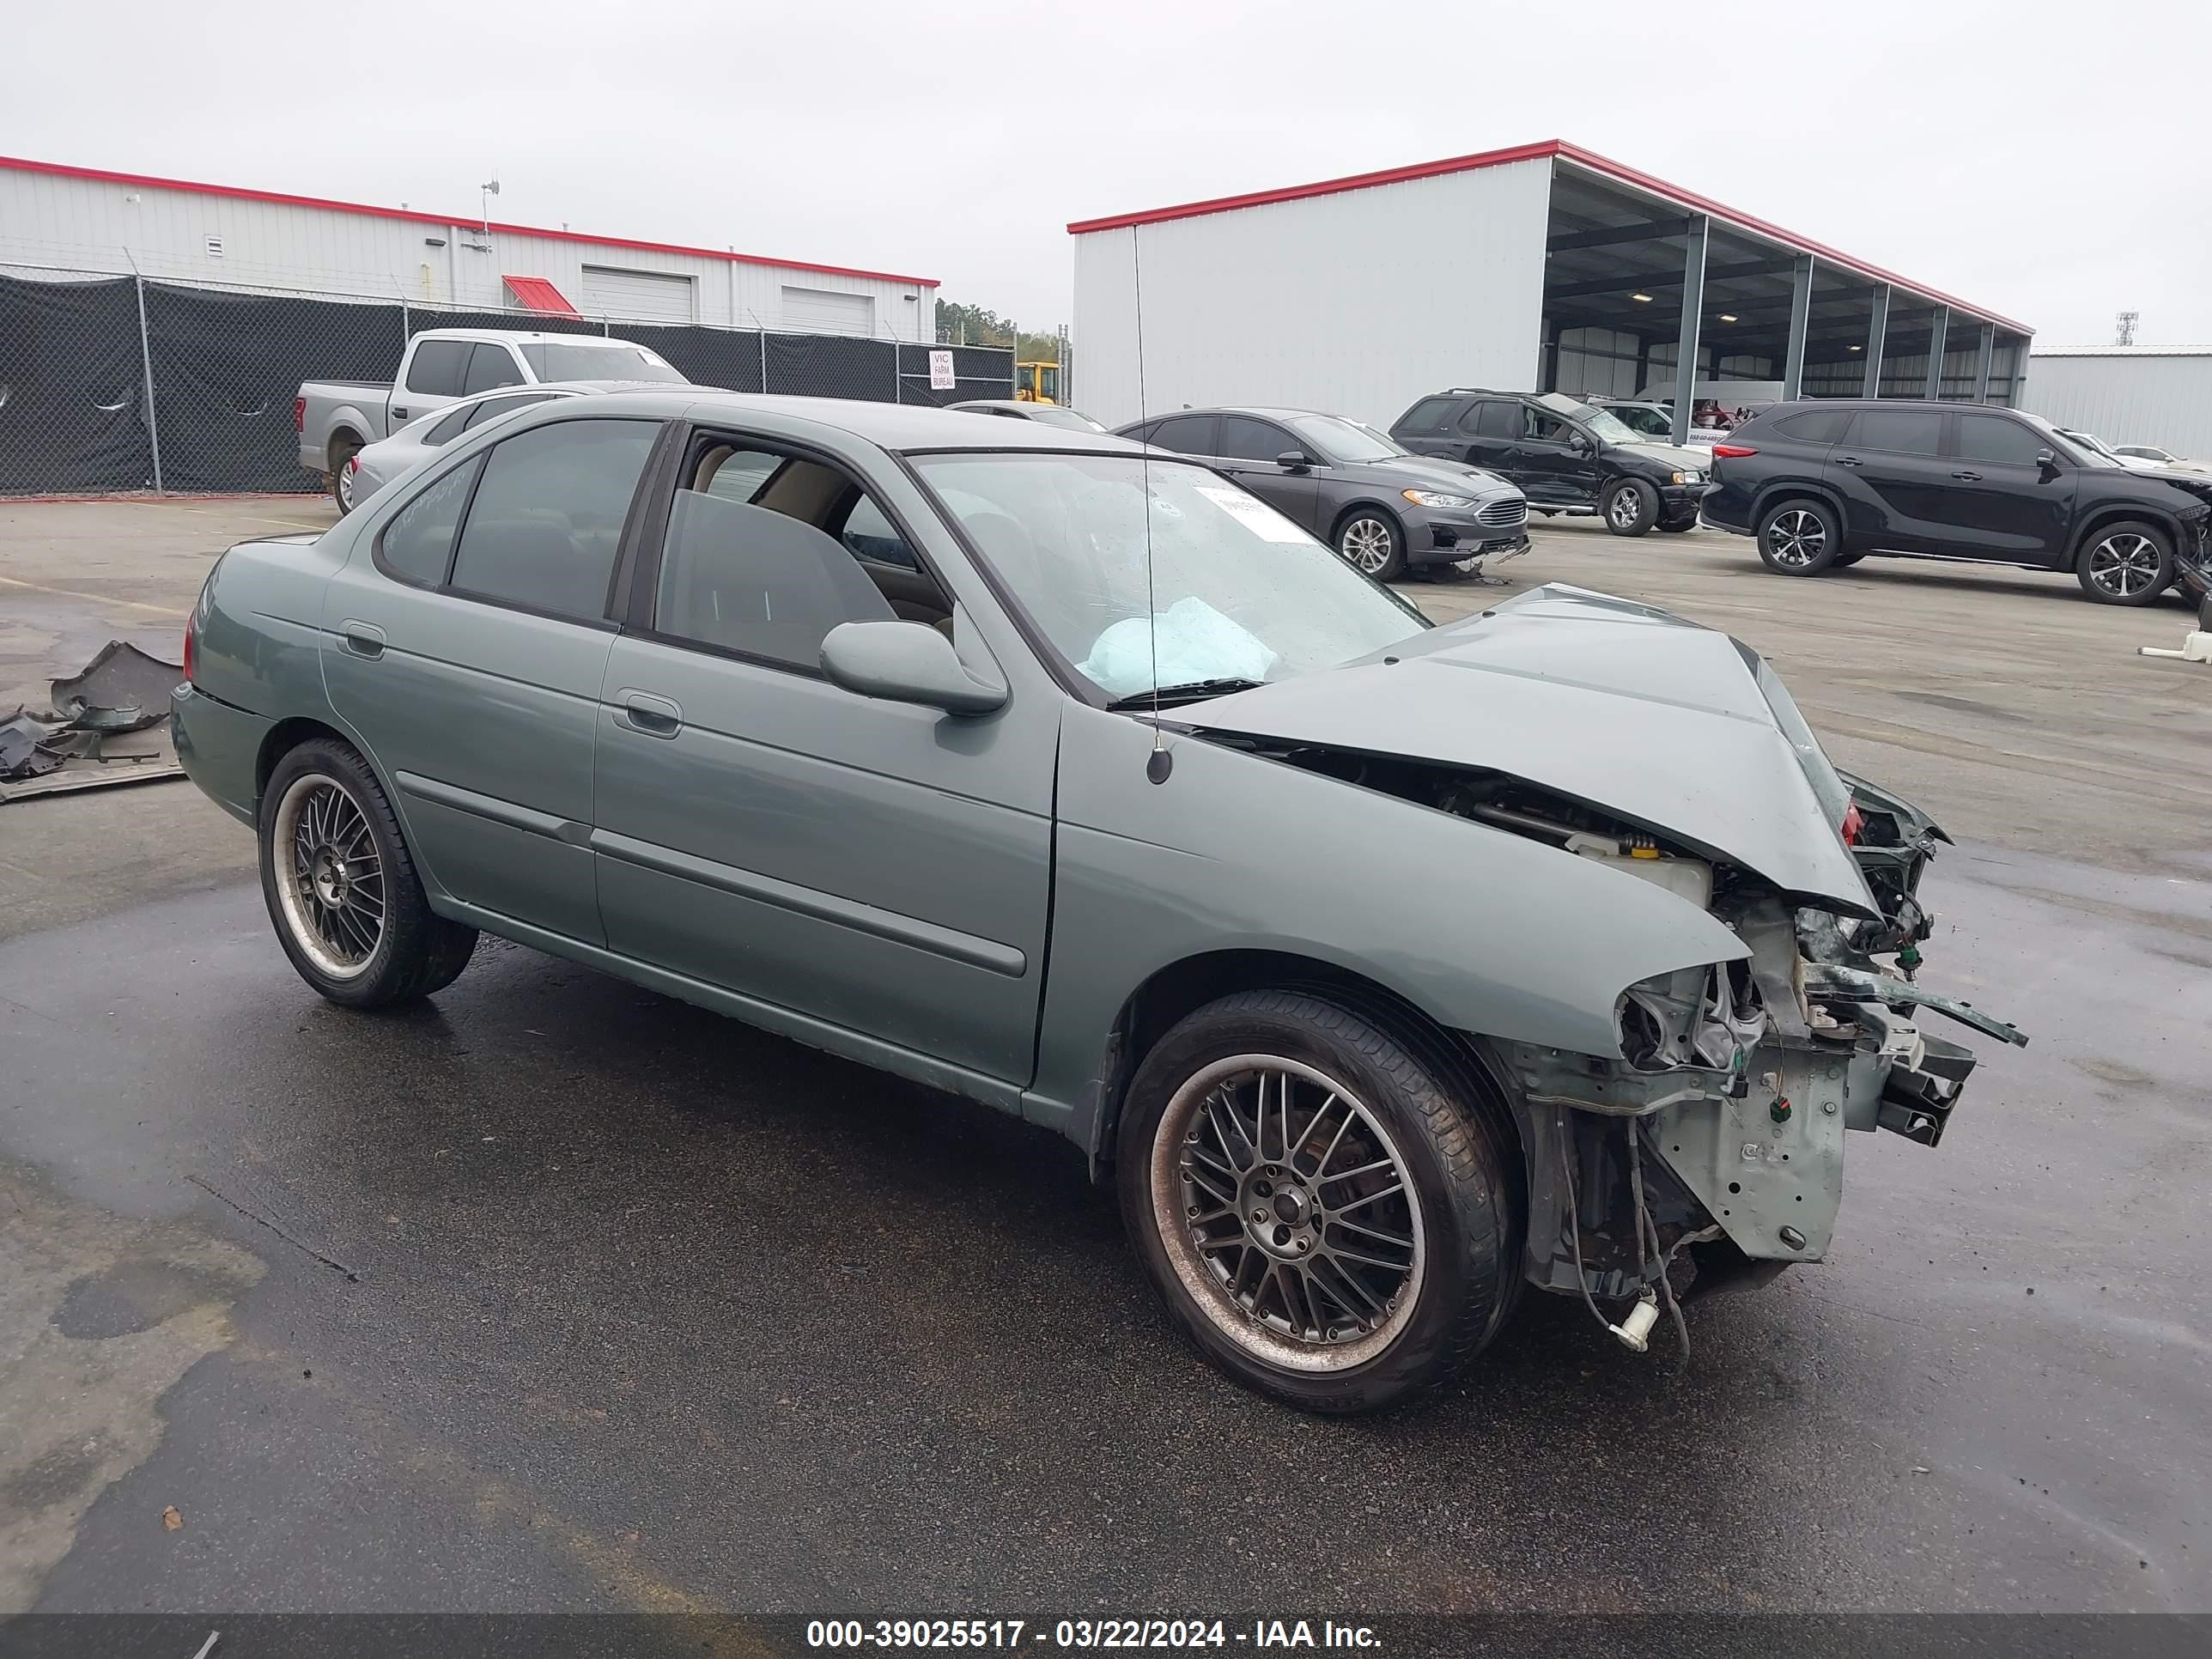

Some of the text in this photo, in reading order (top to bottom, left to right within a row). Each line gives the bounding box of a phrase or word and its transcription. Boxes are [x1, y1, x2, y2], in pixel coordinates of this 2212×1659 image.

[934, 355, 949, 363] VIC
[934, 365, 950, 374] FARM
[933, 378, 953, 386] BUREAU
